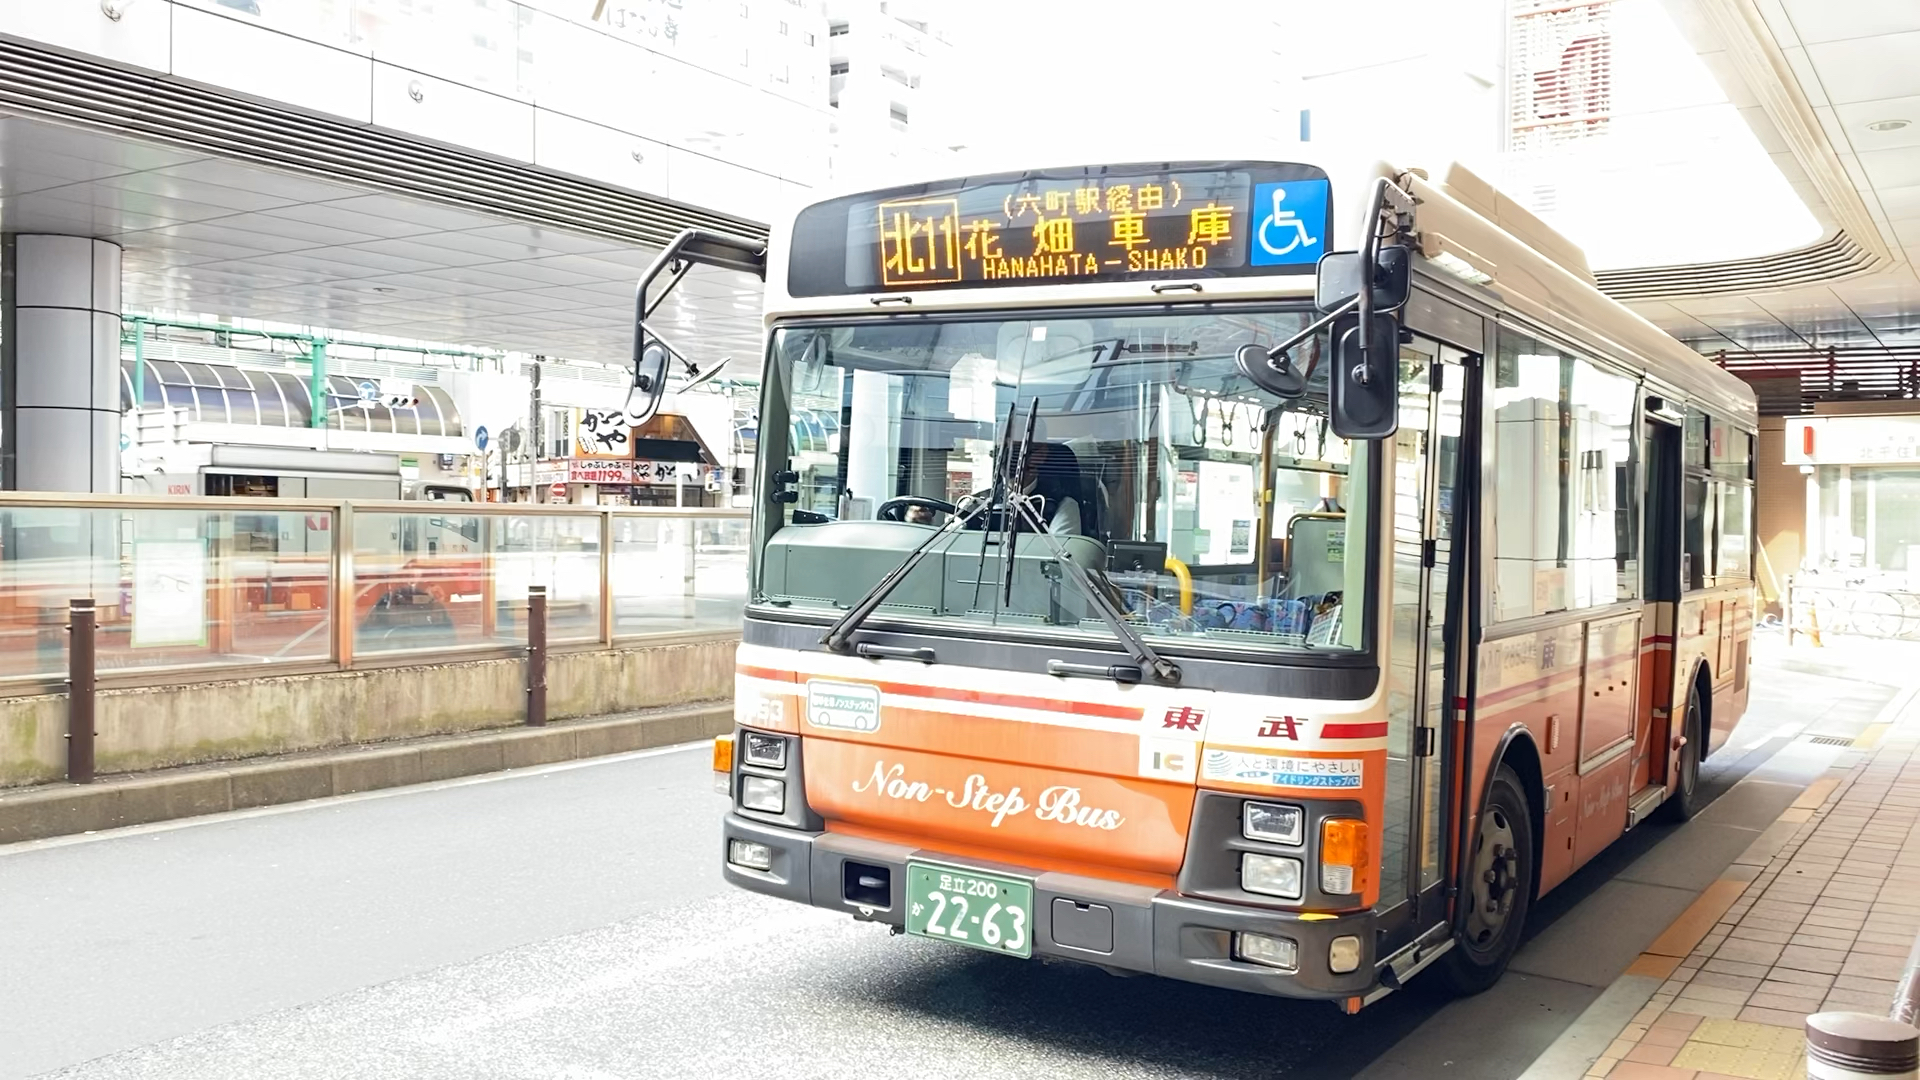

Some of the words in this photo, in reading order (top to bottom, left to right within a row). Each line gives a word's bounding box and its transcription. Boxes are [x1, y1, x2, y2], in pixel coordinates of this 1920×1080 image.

[1003, 181, 1182, 219] (六町駅経由)
[886, 212, 954, 276] 北11
[961, 203, 1234, 260] 花畑車庫
[581, 461, 621, 470] しゃぶしゃぶ
[168, 484, 191, 495] KIRIN
[1162, 706, 1309, 740] 東武
[1237, 756, 1361, 775] 人と環境にやさしい
[1273, 773, 1360, 787] アイドリングストップバス
[852, 760, 1030, 828] Non-Step
[1035, 786, 1126, 831] Bus
[939, 874, 997, 899] 足立200
[911, 902, 925, 916] か
[926, 891, 1025, 949] 22-63
